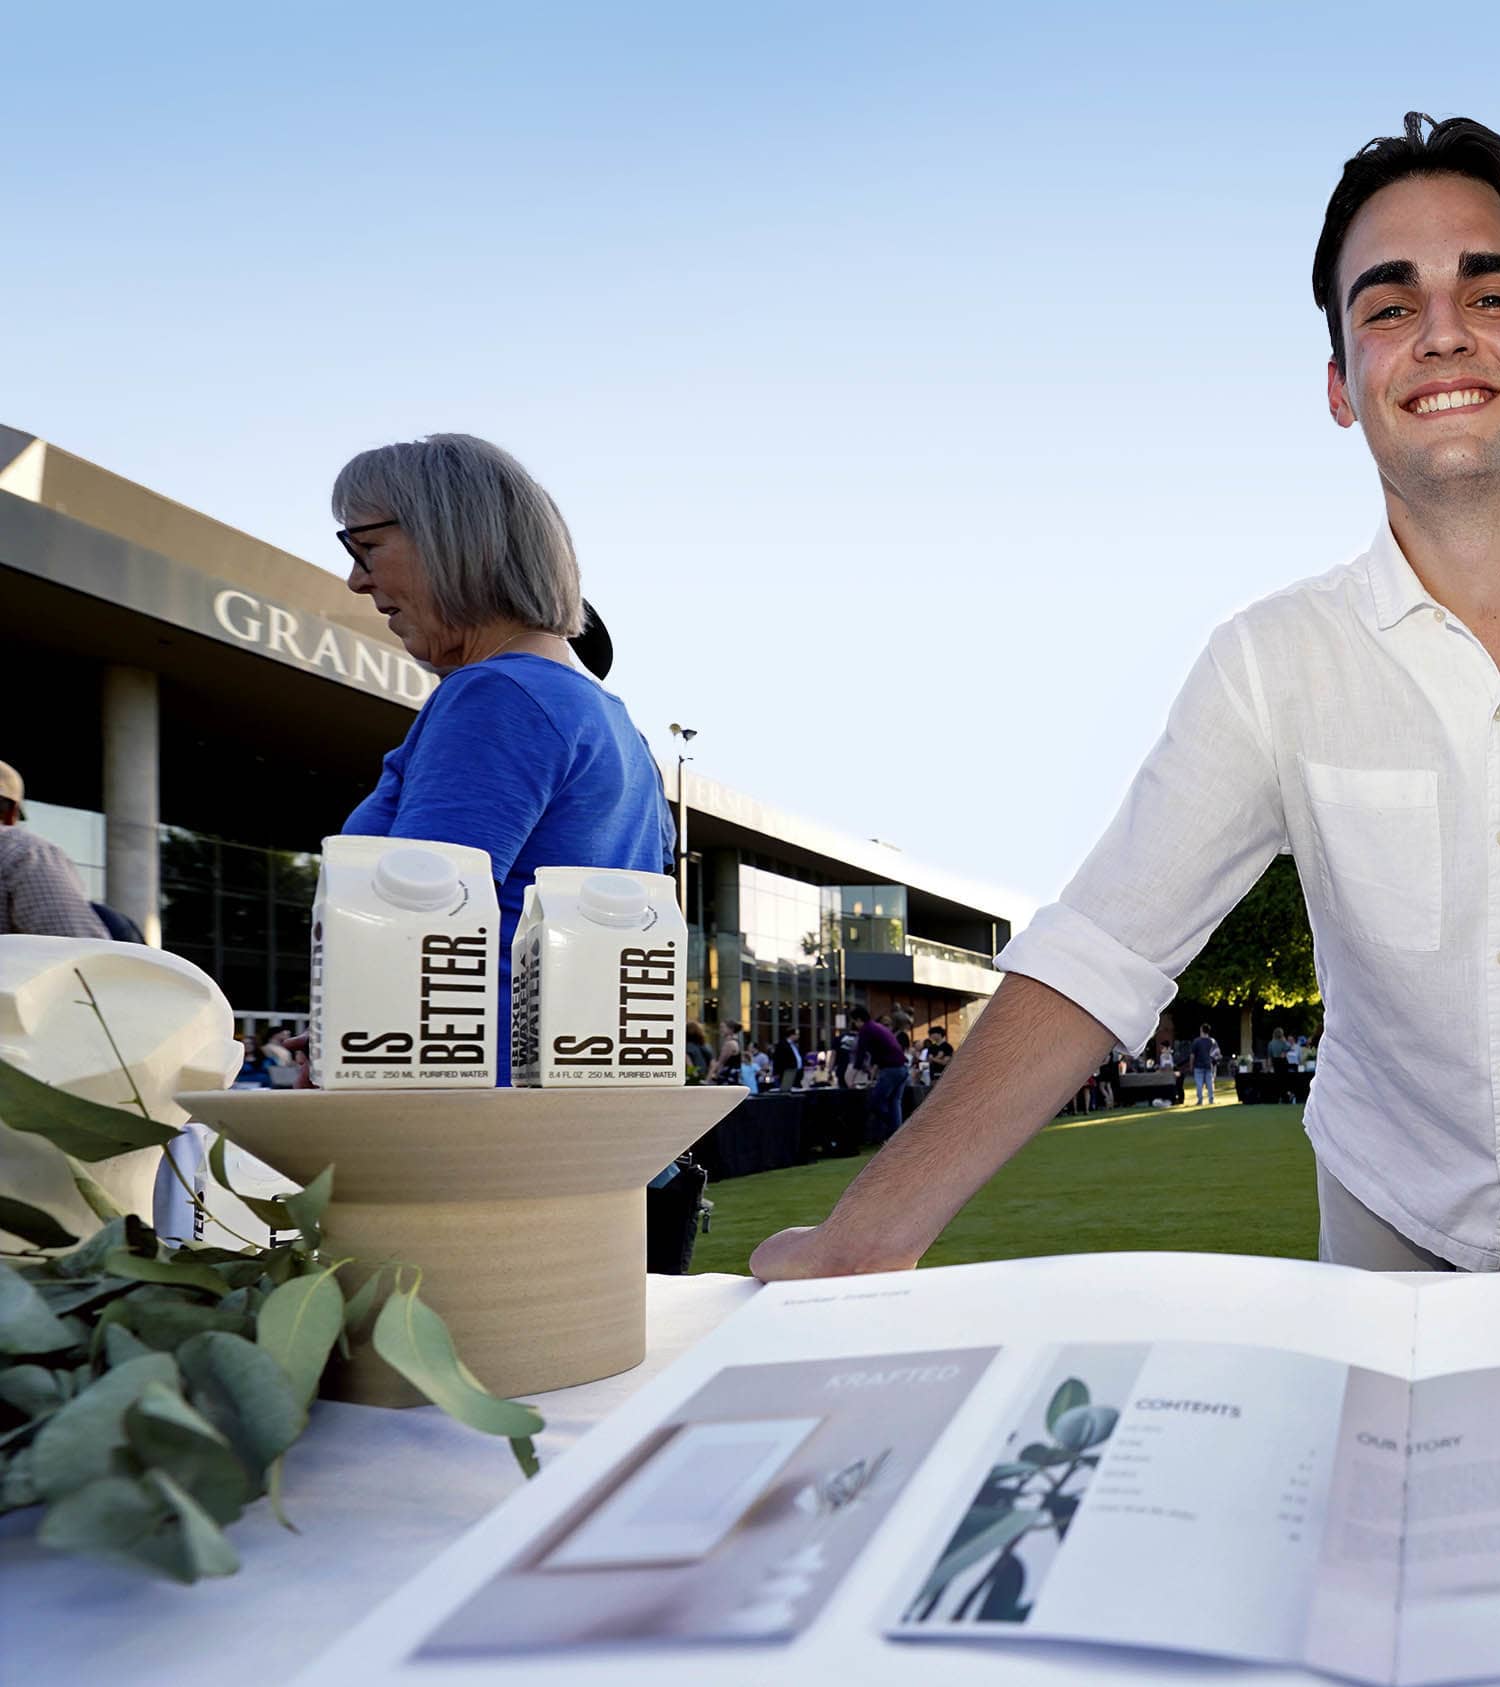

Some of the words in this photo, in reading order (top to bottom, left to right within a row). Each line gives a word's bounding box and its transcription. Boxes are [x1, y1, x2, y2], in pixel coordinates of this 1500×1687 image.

[213, 589, 431, 702] GRAND
[420, 927, 487, 1065] BETTER.
[619, 941, 676, 1066] BETTER.
[341, 1031, 414, 1065] IS
[553, 1035, 614, 1066] IS
[335, 1071, 349, 1079] 8.4
[351, 1071, 363, 1079] FL
[364, 1071, 377, 1079] OZ
[383, 1071, 400, 1079] 250
[401, 1071, 415, 1079] ML
[419, 1070, 458, 1079] PURIFIED
[460, 1070, 489, 1079] WATER
[548, 1071, 561, 1079] 8.4
[562, 1071, 572, 1079] FL
[573, 1071, 584, 1079] OZ
[588, 1071, 603, 1079] 250
[603, 1071, 616, 1079] ML
[618, 1071, 651, 1079] PURIFIED
[652, 1071, 677, 1079] WATER
[824, 1364, 961, 1390] KRAFTED
[1135, 1399, 1242, 1418] CONTENTS
[1356, 1431, 1398, 1450] OUR
